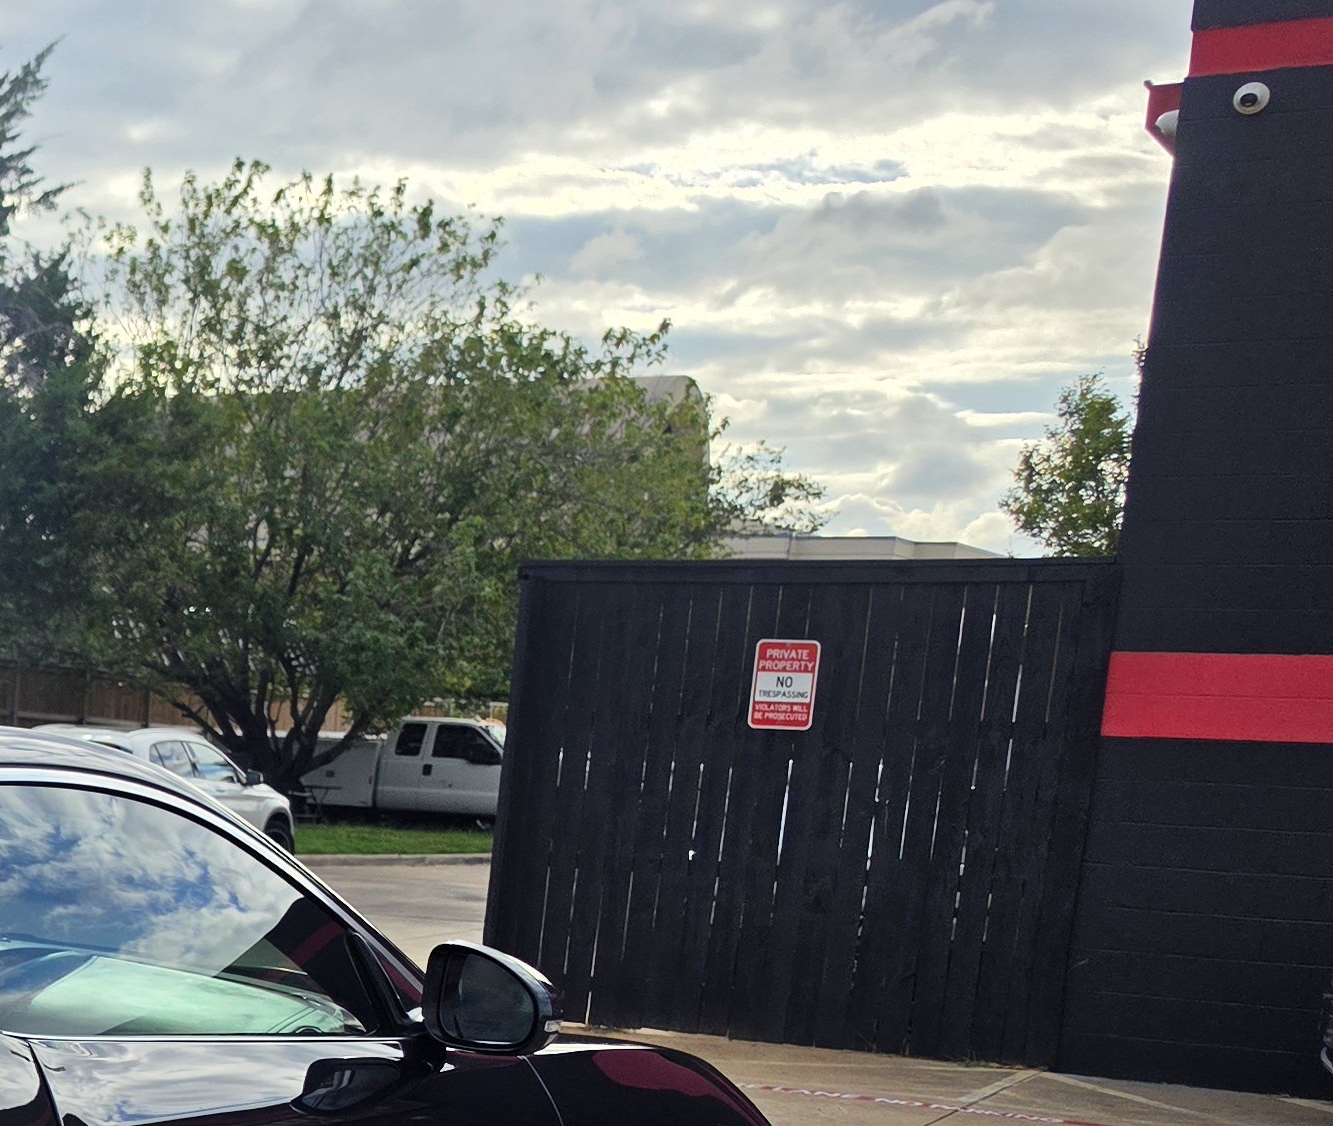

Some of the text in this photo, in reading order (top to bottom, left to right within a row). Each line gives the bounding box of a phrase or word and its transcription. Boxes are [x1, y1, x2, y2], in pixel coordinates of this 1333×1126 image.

[766, 649, 809, 660] PRIVATE
[759, 660, 814, 671] PROPERTY
[776, 676, 794, 688] NO
[759, 690, 808, 699] TRESPASSING
